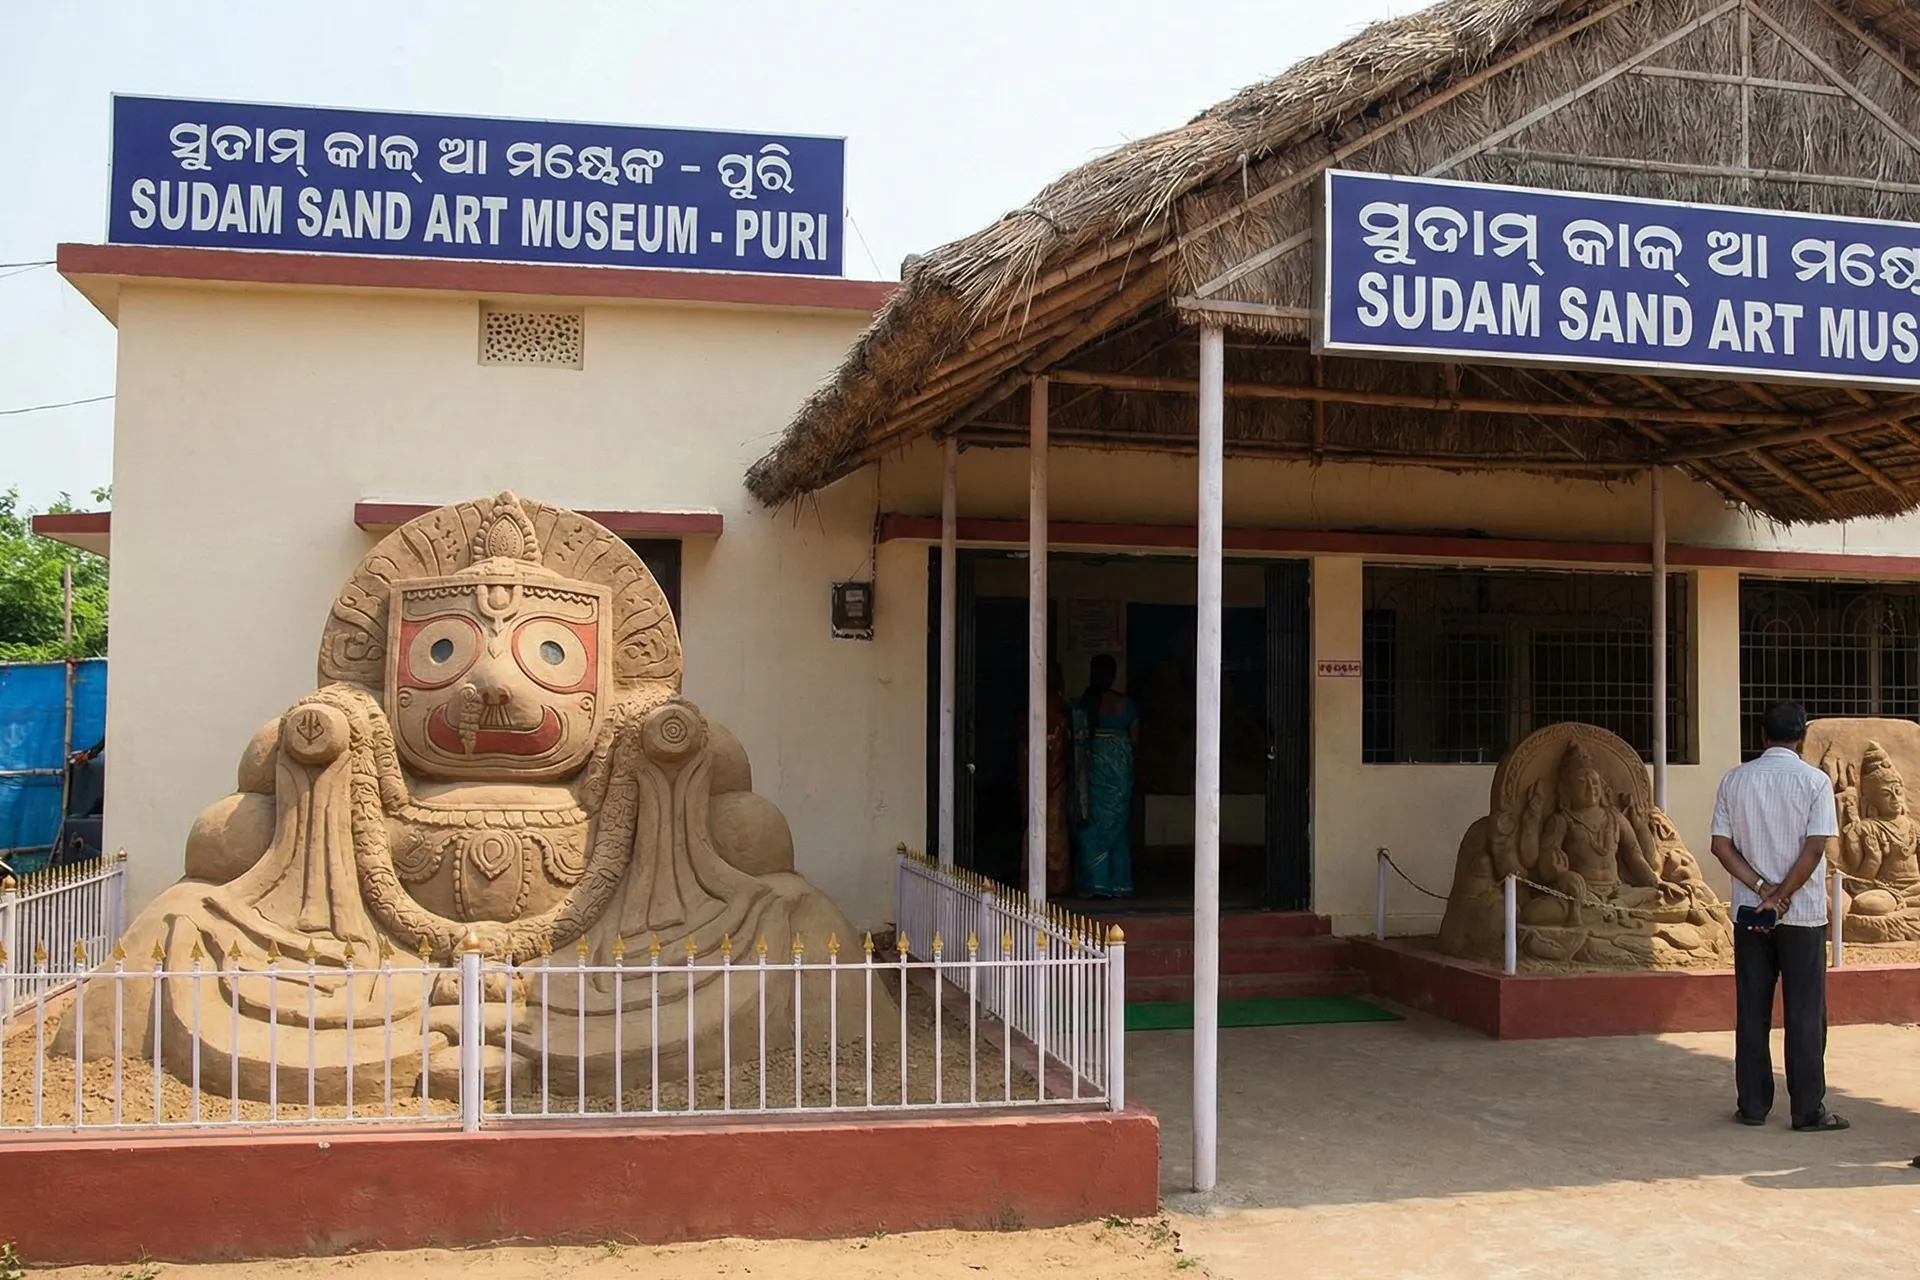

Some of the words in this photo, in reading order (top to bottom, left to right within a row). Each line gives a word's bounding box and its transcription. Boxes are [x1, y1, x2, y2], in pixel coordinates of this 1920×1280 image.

[129, 178, 283, 235] SUDAM
[297, 186, 412, 240] SAND
[423, 193, 508, 245] ART
[521, 198, 698, 255] MUSEUM
[735, 209, 828, 261] PURI
[1356, 271, 1540, 338] SUDAM
[1558, 286, 1693, 347] SAND
[1707, 298, 1804, 355] ART
[1819, 306, 1919, 364] MUS
